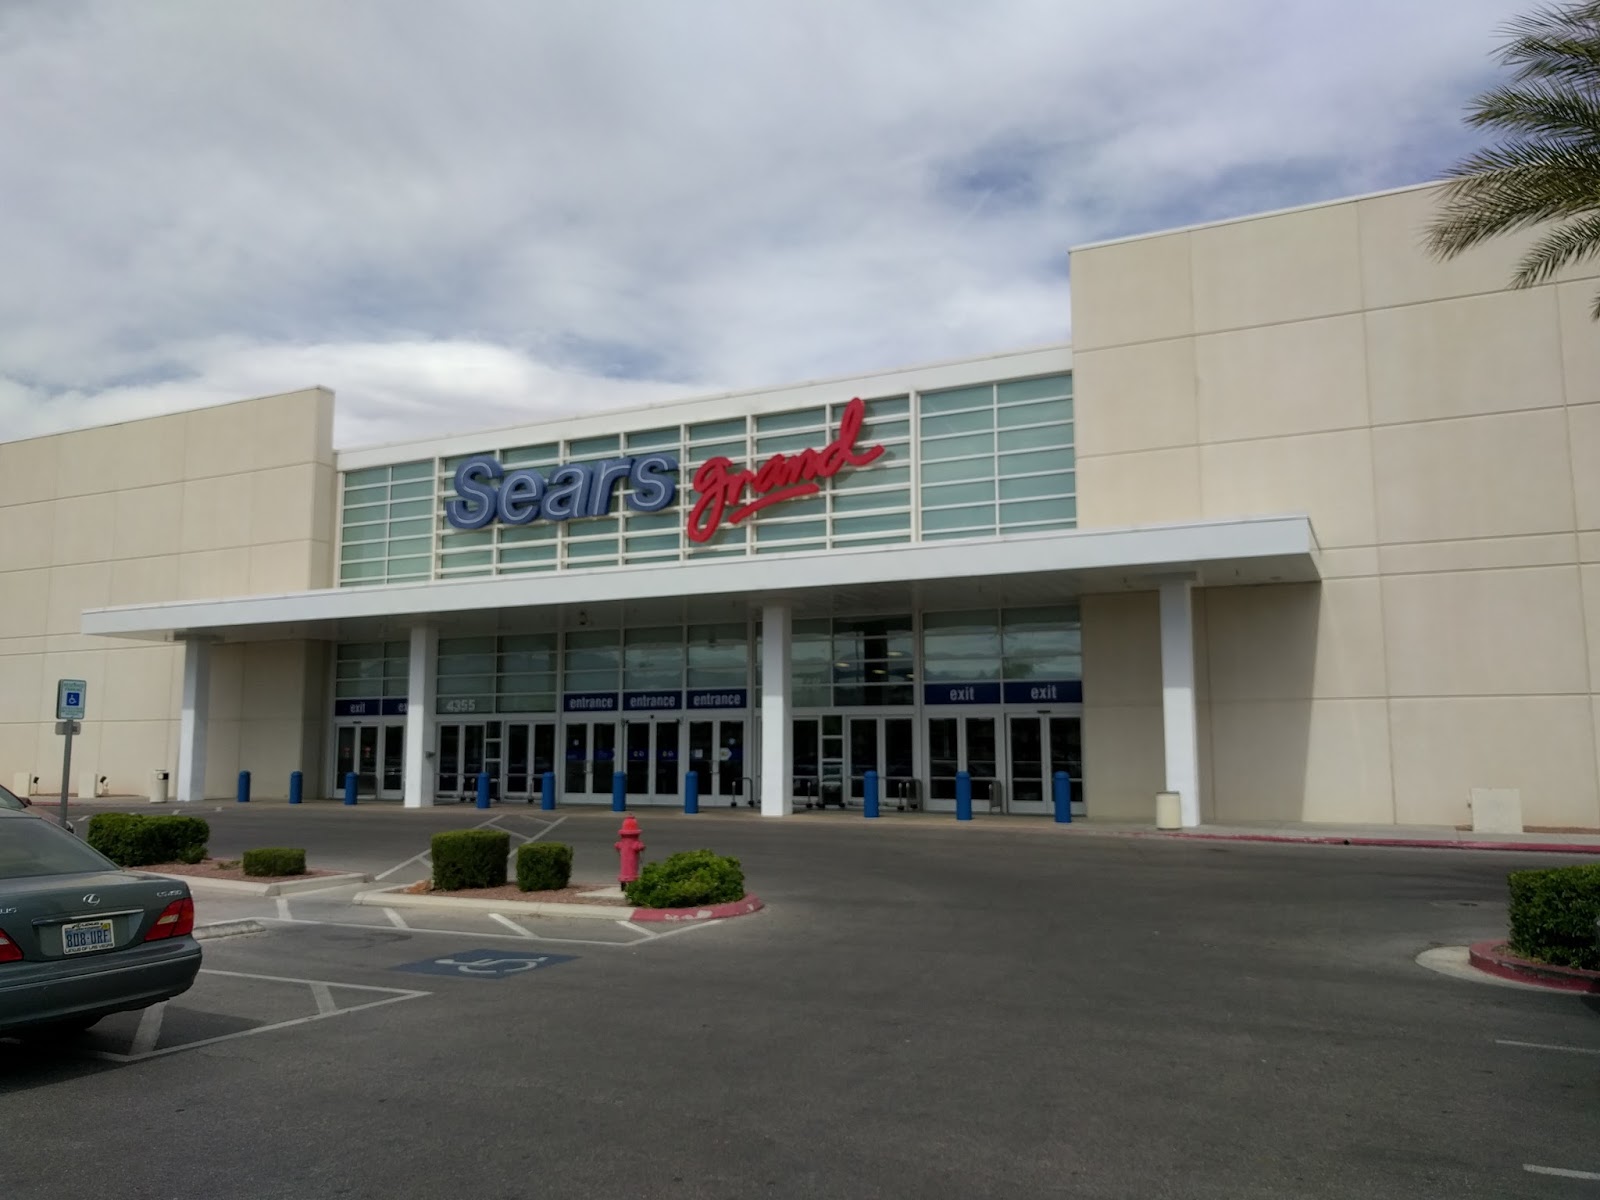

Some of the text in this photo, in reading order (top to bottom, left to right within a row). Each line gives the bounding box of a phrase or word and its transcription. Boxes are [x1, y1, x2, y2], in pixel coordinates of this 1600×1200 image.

[446, 397, 884, 542] Sears grand
[950, 686, 975, 701] exit
[1030, 684, 1057, 699] exit
[569, 695, 613, 708] entrance
[630, 694, 675, 707] entrance
[693, 692, 741, 706] entrance
[350, 702, 366, 713] exit
[398, 702, 408, 712] ex
[445, 700, 476, 712] 4355
